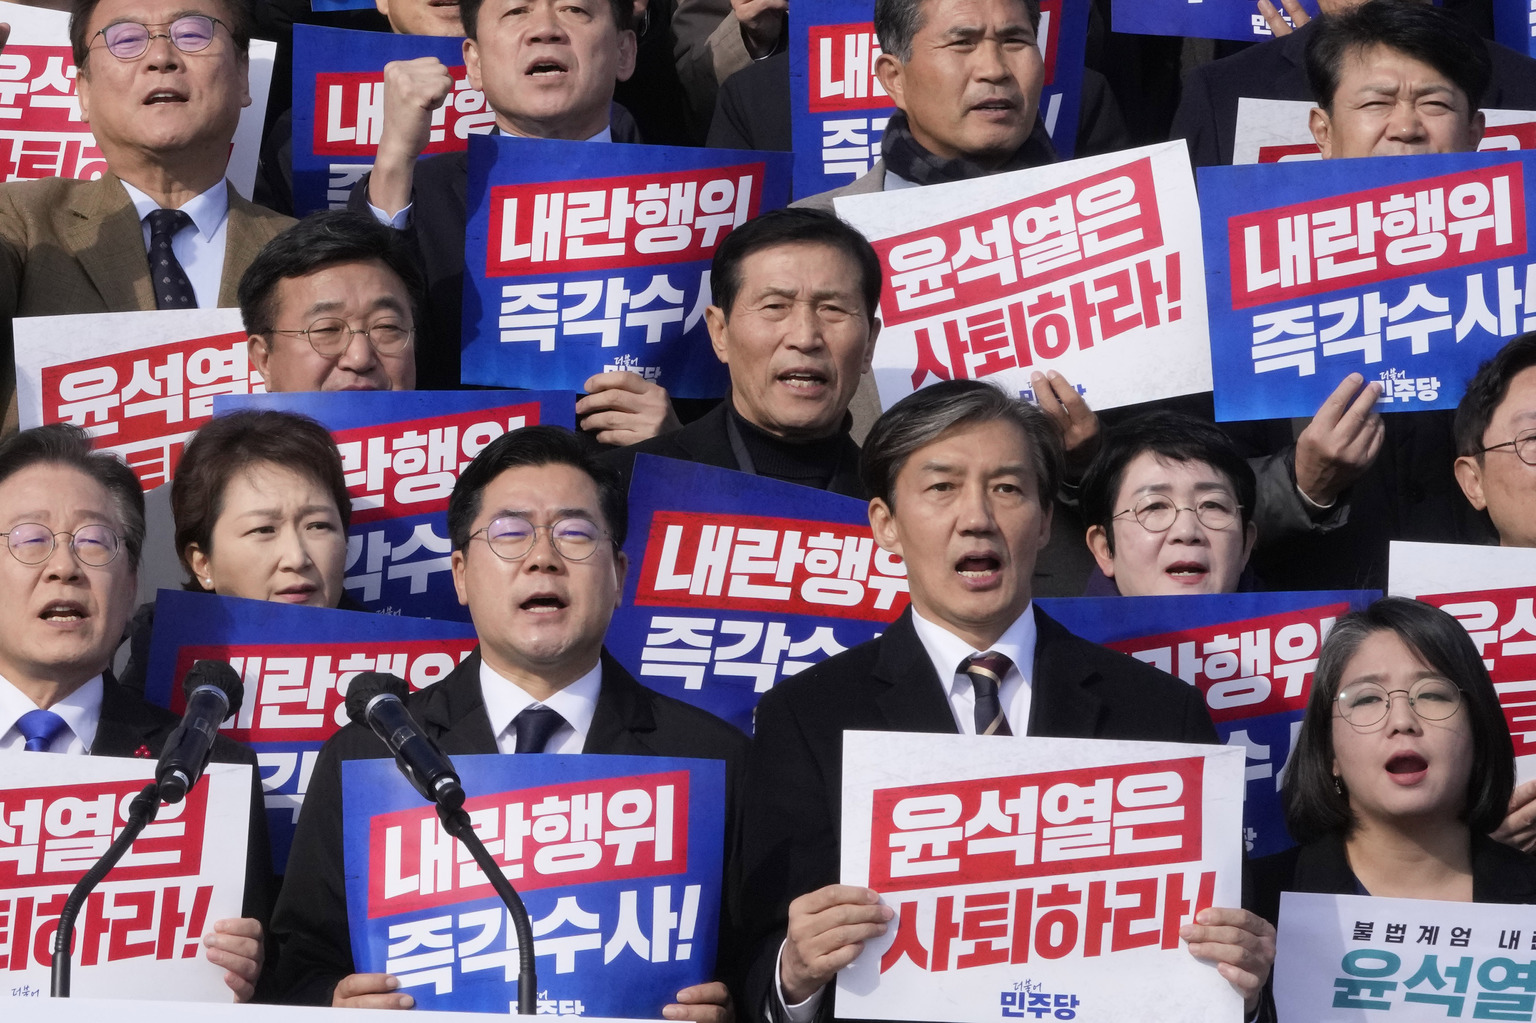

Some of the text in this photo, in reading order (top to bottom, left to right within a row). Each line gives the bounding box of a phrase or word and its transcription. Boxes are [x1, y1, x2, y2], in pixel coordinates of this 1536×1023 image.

[500, 175, 754, 264] 내란행위
[888, 176, 1144, 311] 윤석열은
[1244, 175, 1514, 293] 내란행위
[911, 251, 1183, 392] 사퇴하라!
[58, 340, 256, 436] 윤석열
[384, 785, 675, 900] 내란행위
[889, 770, 1185, 879] 윤석열은
[385, 884, 702, 996] 즉각수사!
[880, 870, 1217, 975] 사퇴하라!
[1352, 920, 1473, 950] 불법계엄
[1000, 989, 1080, 1022] 민주당
[1332, 947, 1536, 1023] 윤석열
